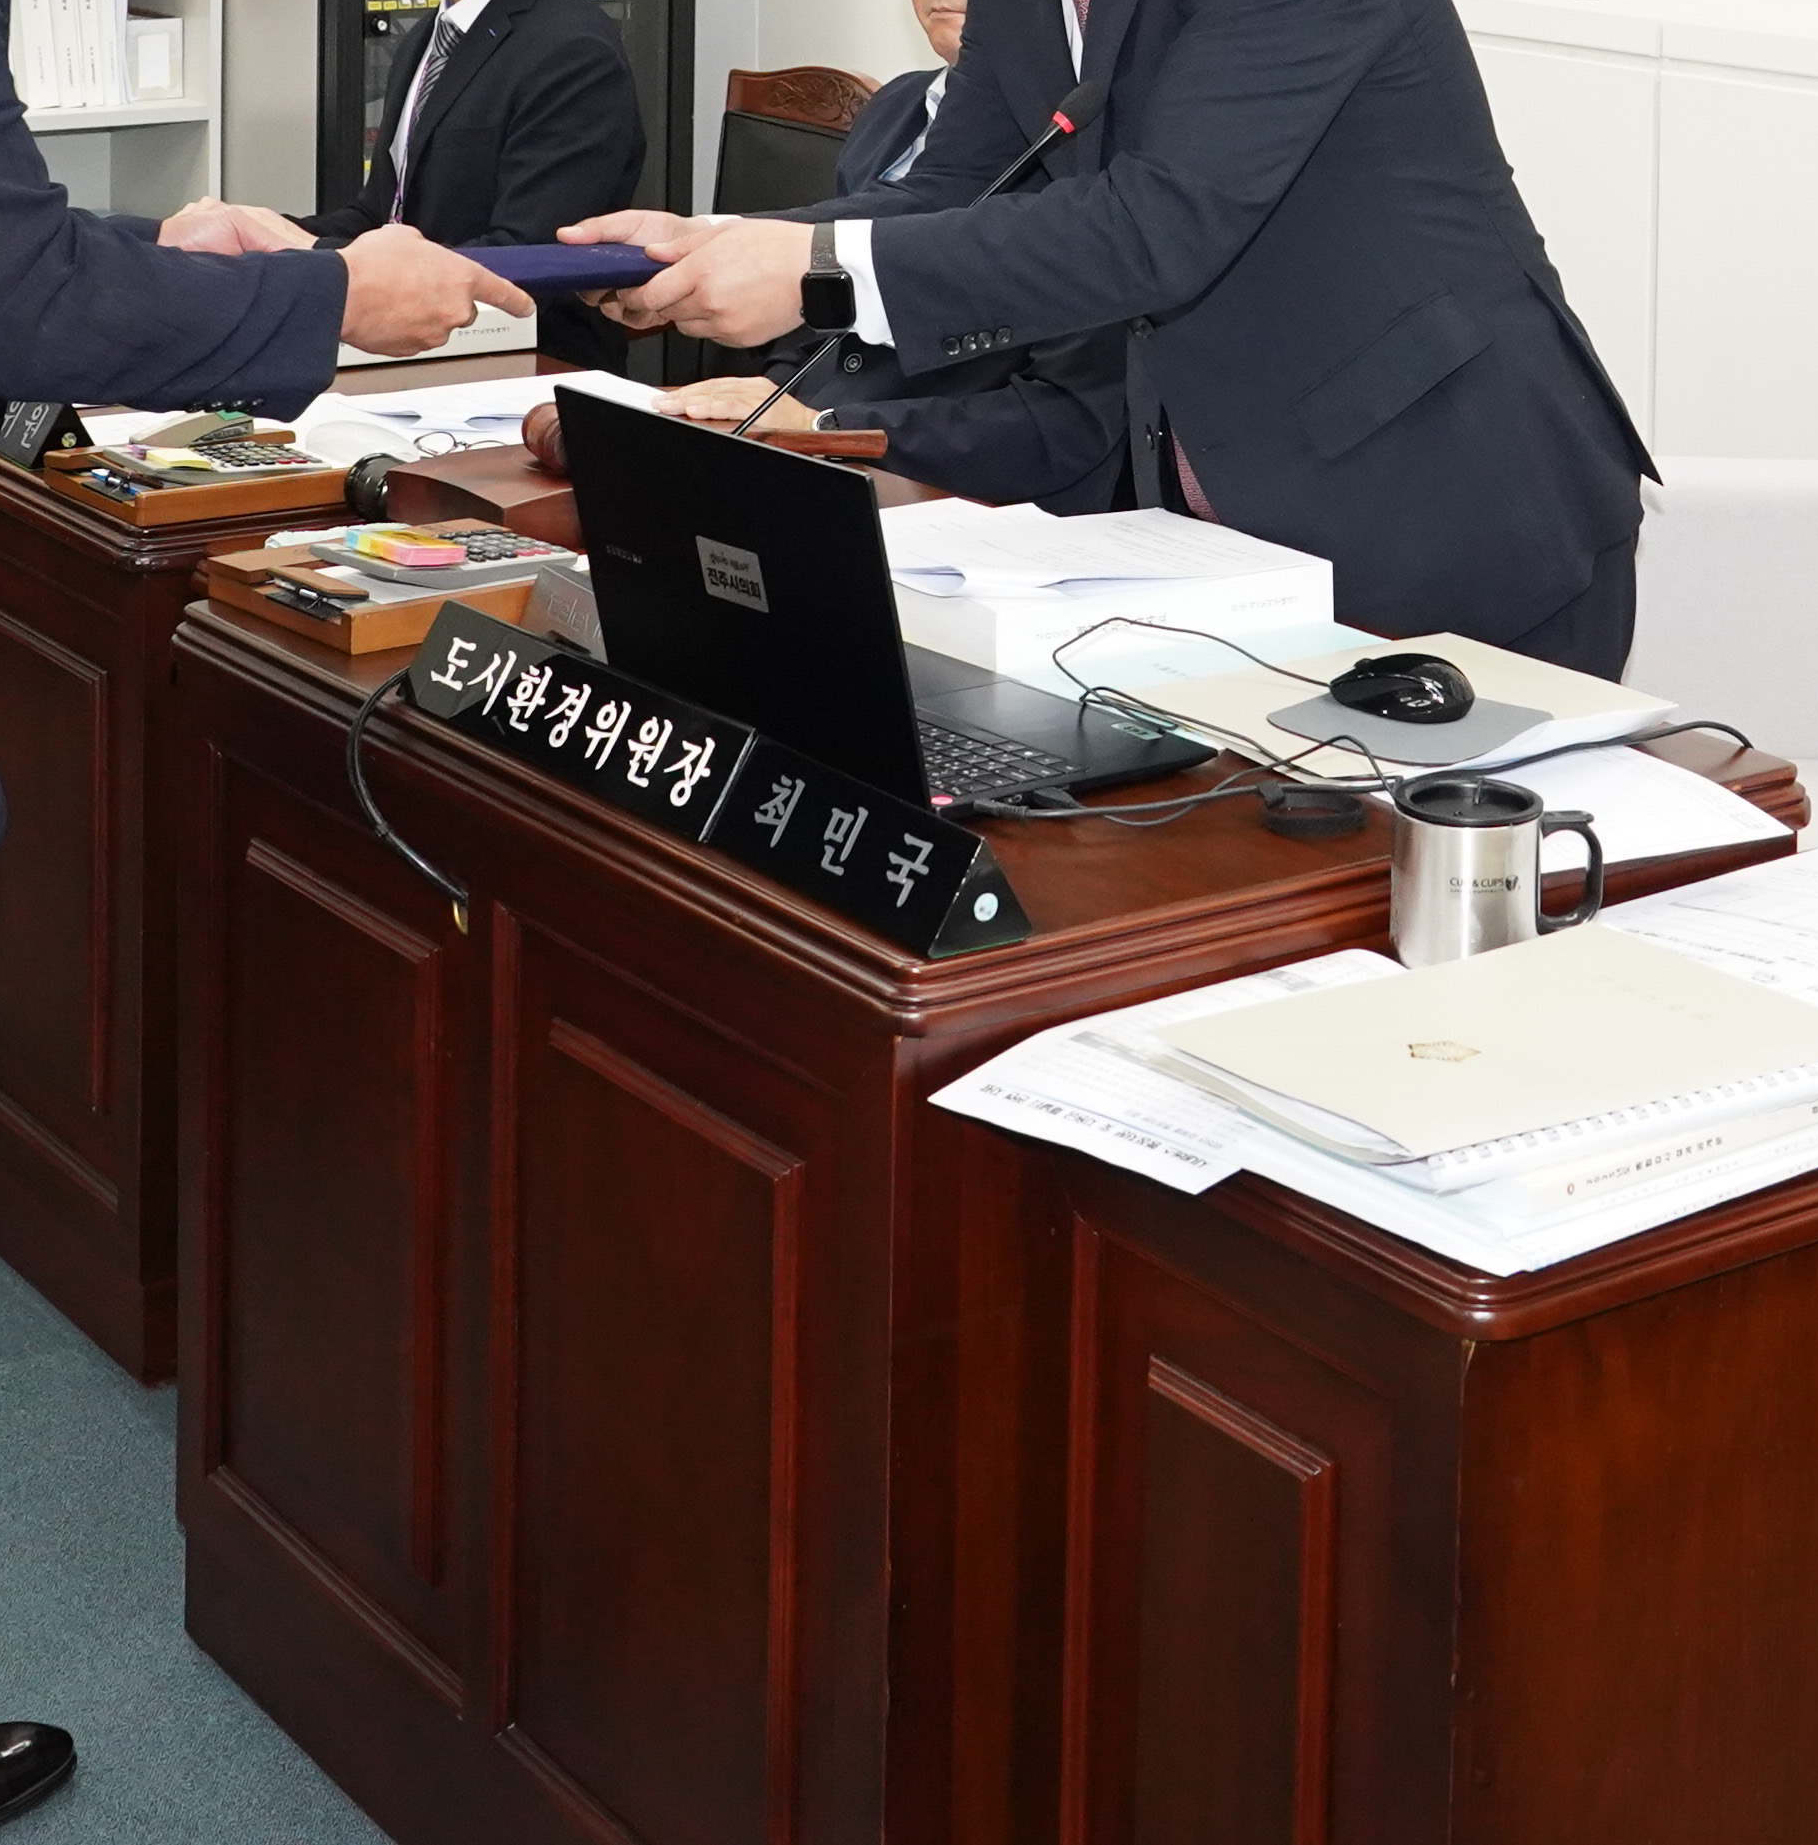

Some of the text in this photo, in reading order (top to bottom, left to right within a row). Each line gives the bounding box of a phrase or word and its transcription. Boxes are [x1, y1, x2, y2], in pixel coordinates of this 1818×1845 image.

[706, 567, 763, 601] 진주시의회
[429, 635, 716, 807] 도시환경위원장
[1449, 877, 1470, 887] CU
